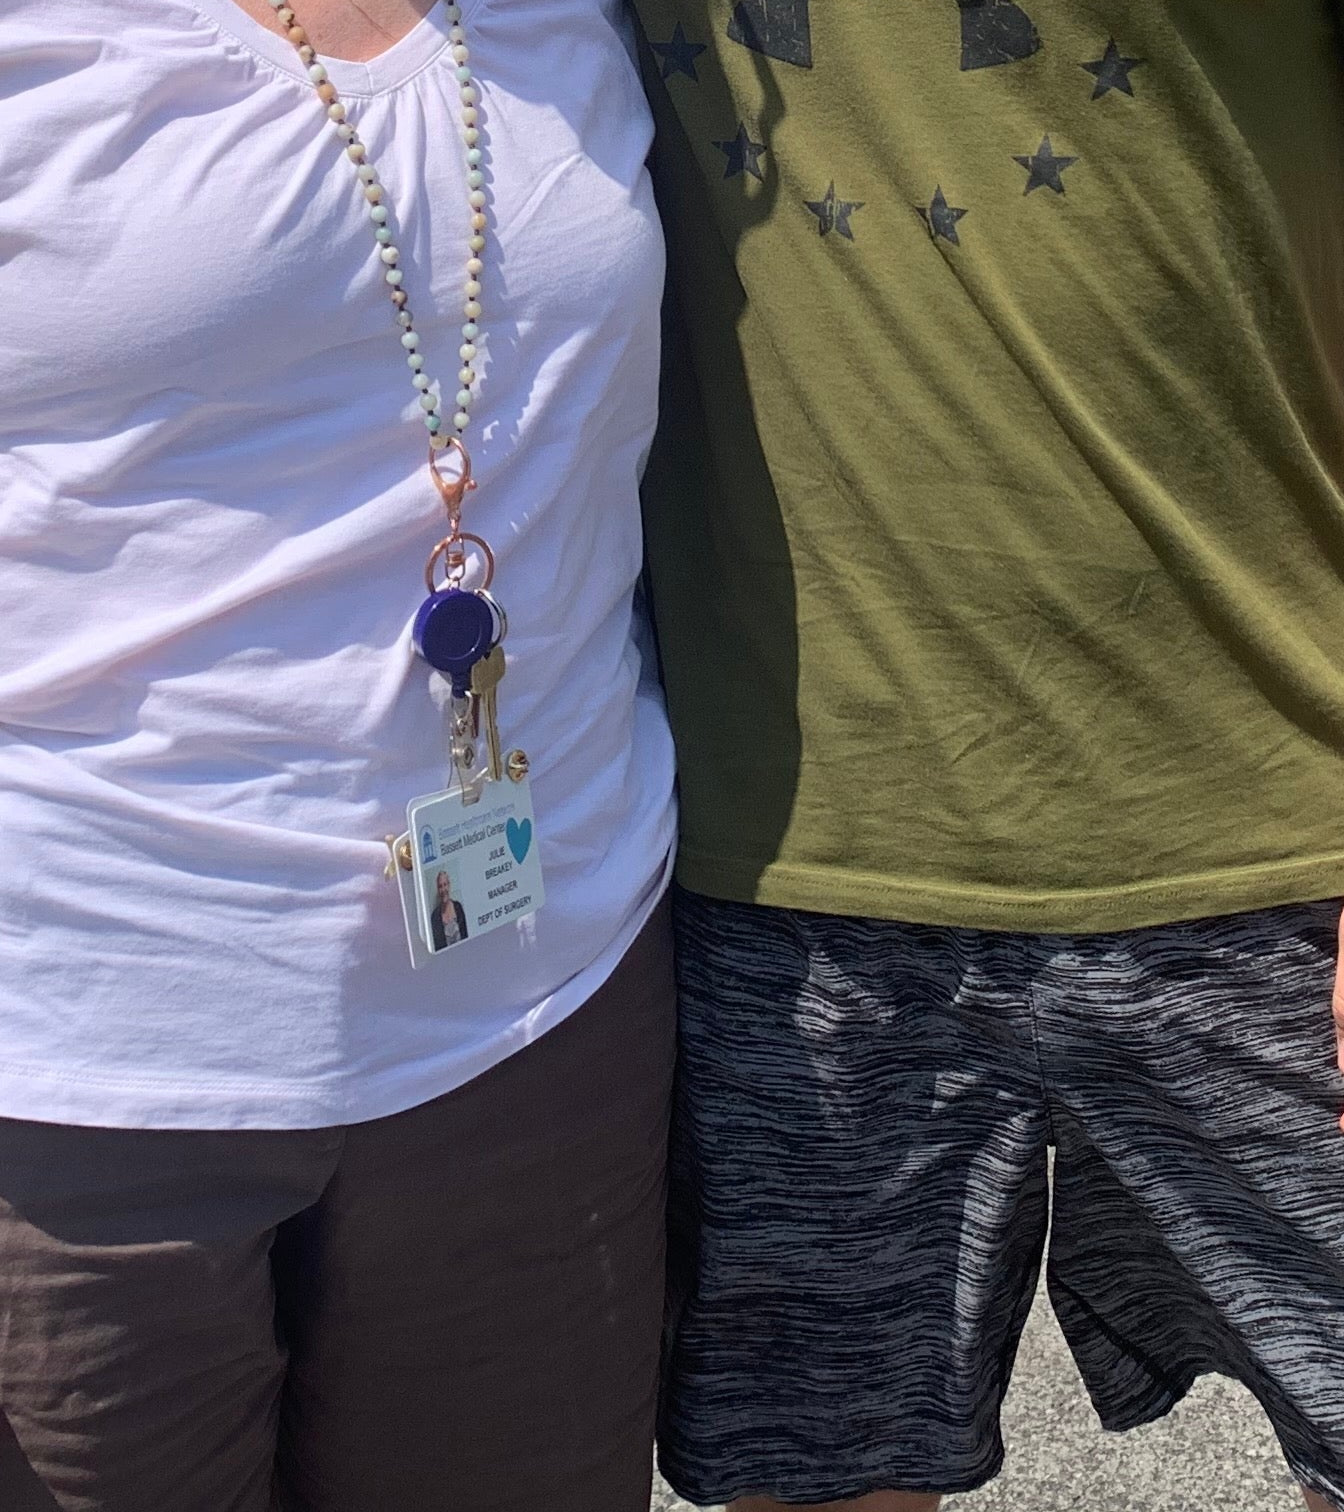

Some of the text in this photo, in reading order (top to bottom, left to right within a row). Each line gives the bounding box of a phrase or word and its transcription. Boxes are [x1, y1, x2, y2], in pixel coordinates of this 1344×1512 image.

[487, 879, 518, 900] MANAGER
[477, 895, 532, 926] DEPT OF SURGERY
